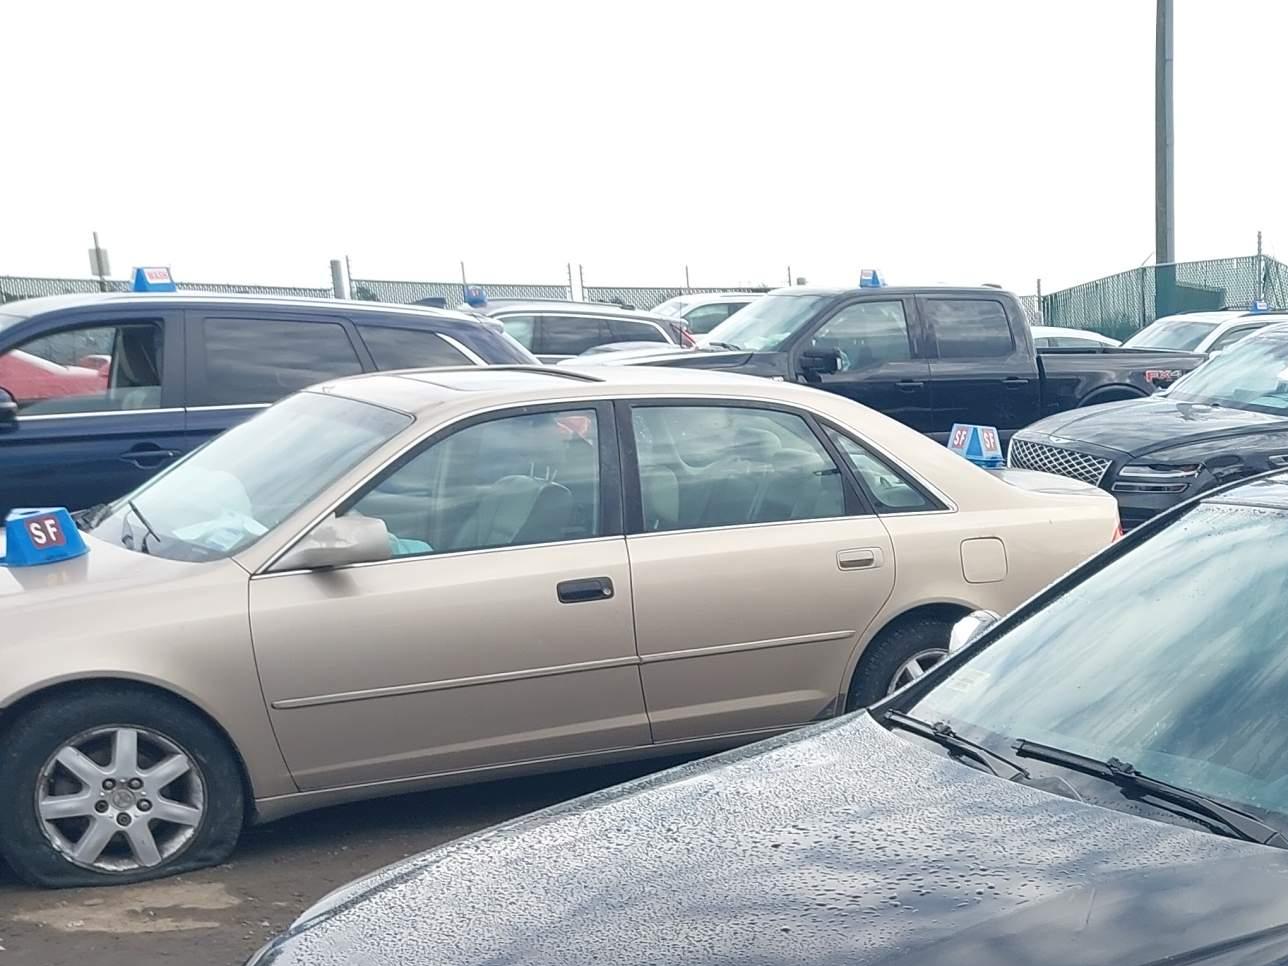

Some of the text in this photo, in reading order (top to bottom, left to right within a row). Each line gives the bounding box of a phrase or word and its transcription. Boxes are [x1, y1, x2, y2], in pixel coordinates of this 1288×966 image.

[953, 430, 967, 446] SF
[983, 431, 996, 449] SF
[30, 519, 57, 544] SF
